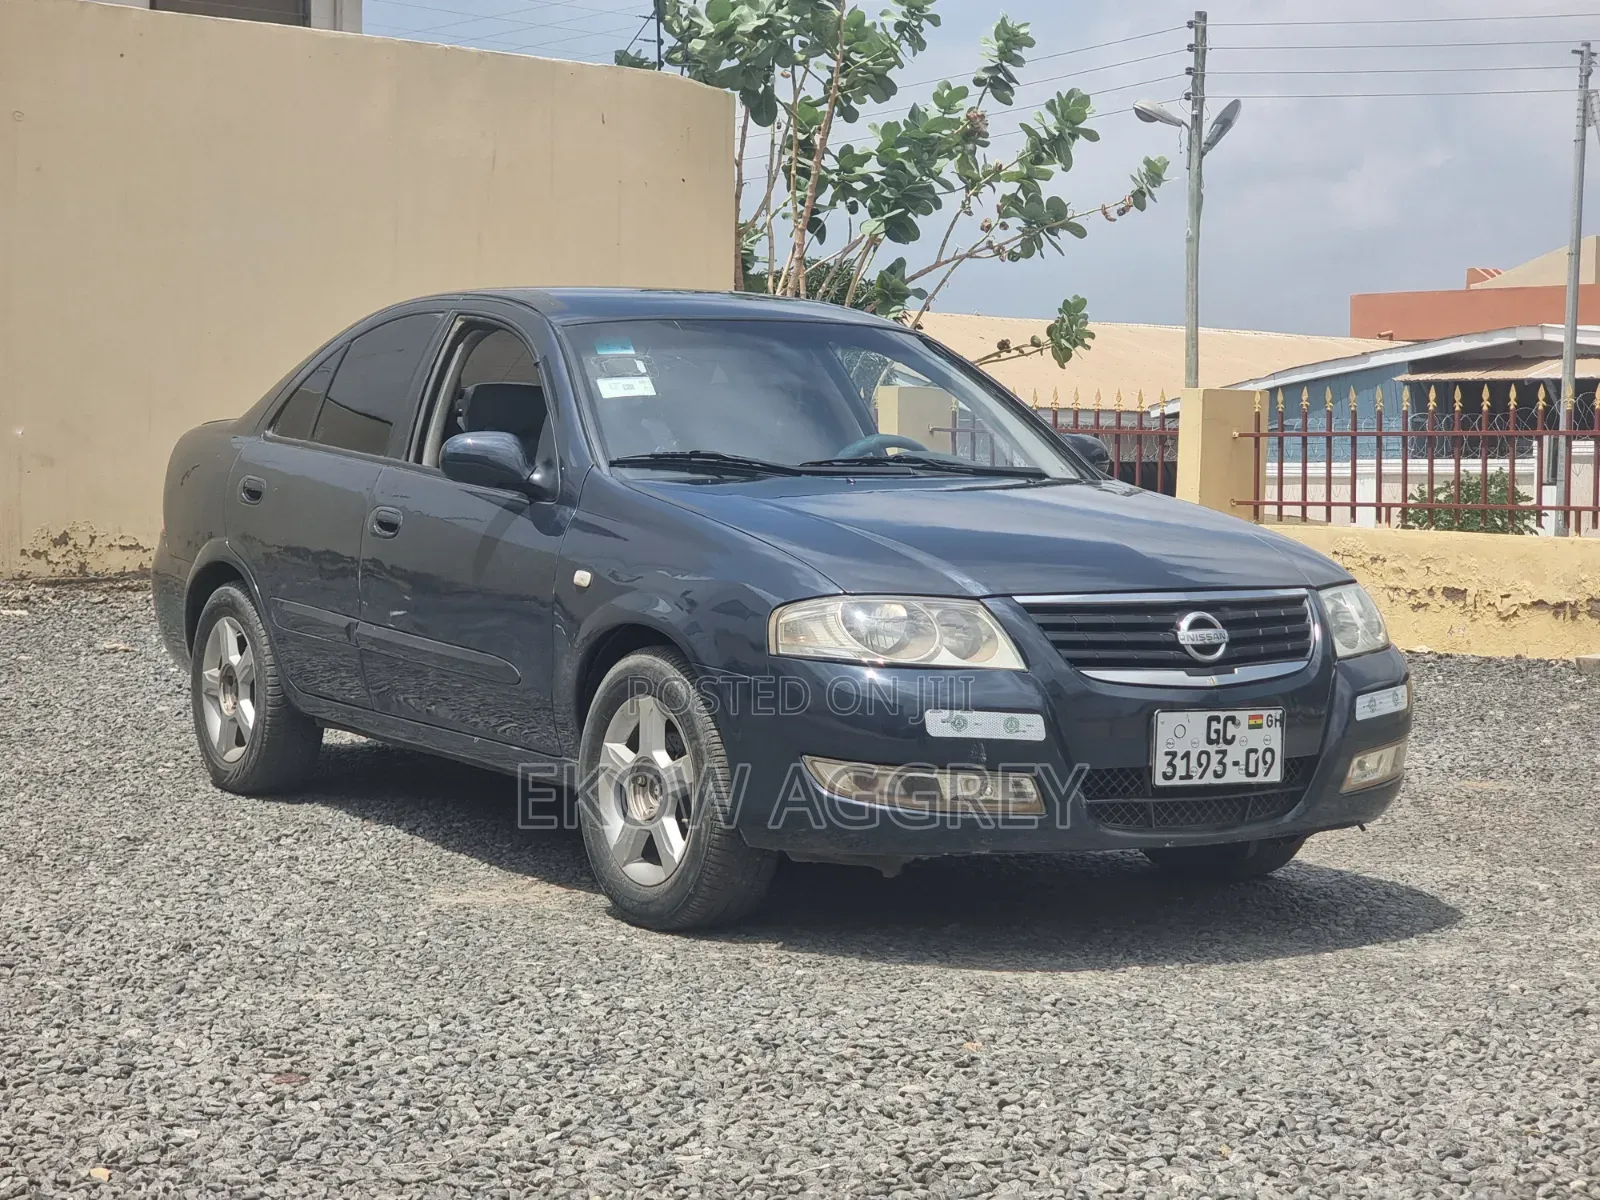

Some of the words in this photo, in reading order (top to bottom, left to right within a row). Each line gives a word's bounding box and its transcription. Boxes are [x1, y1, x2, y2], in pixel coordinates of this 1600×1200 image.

[1186, 632, 1226, 642] NISSAN
[1206, 715, 1237, 746] GC
[1266, 713, 1282, 728] GH
[1162, 747, 1276, 780] 3193-09
